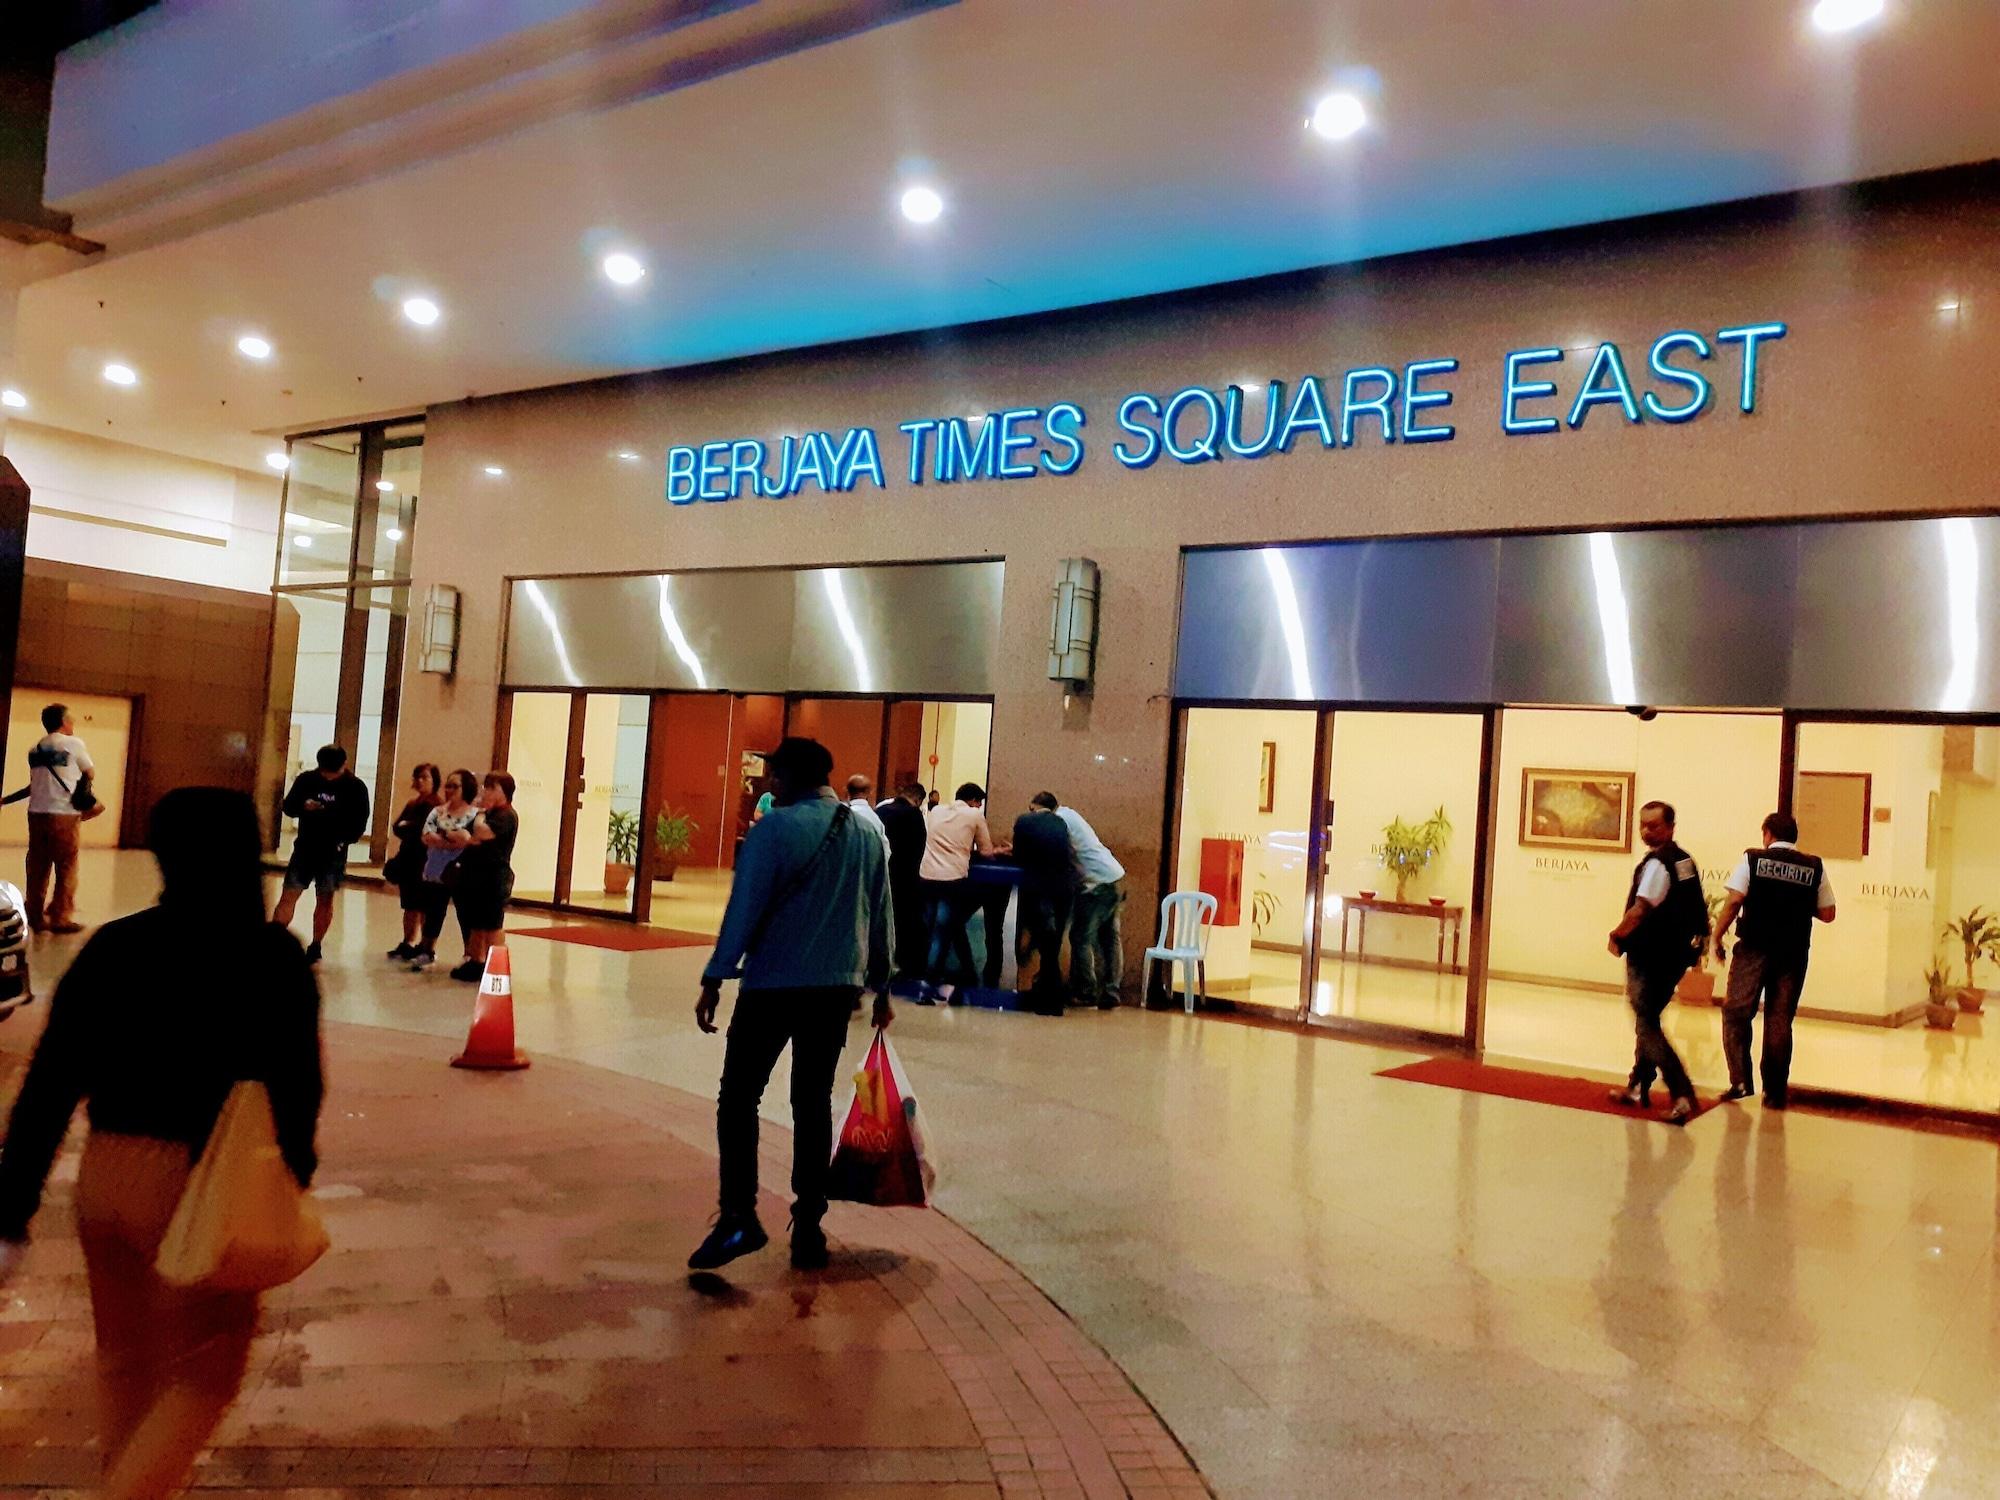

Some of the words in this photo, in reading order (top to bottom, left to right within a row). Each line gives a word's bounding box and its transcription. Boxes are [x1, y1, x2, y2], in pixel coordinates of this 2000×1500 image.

[667, 429, 886, 504] BERJAYA
[900, 403, 1085, 484] TIMES
[1114, 358, 1459, 469] SQUARE
[1501, 321, 1787, 435] EAST
[1536, 857, 1590, 872] BERJAYA
[1758, 860, 1814, 884] SECURITY
[1862, 884, 1930, 900] BERJAYA
